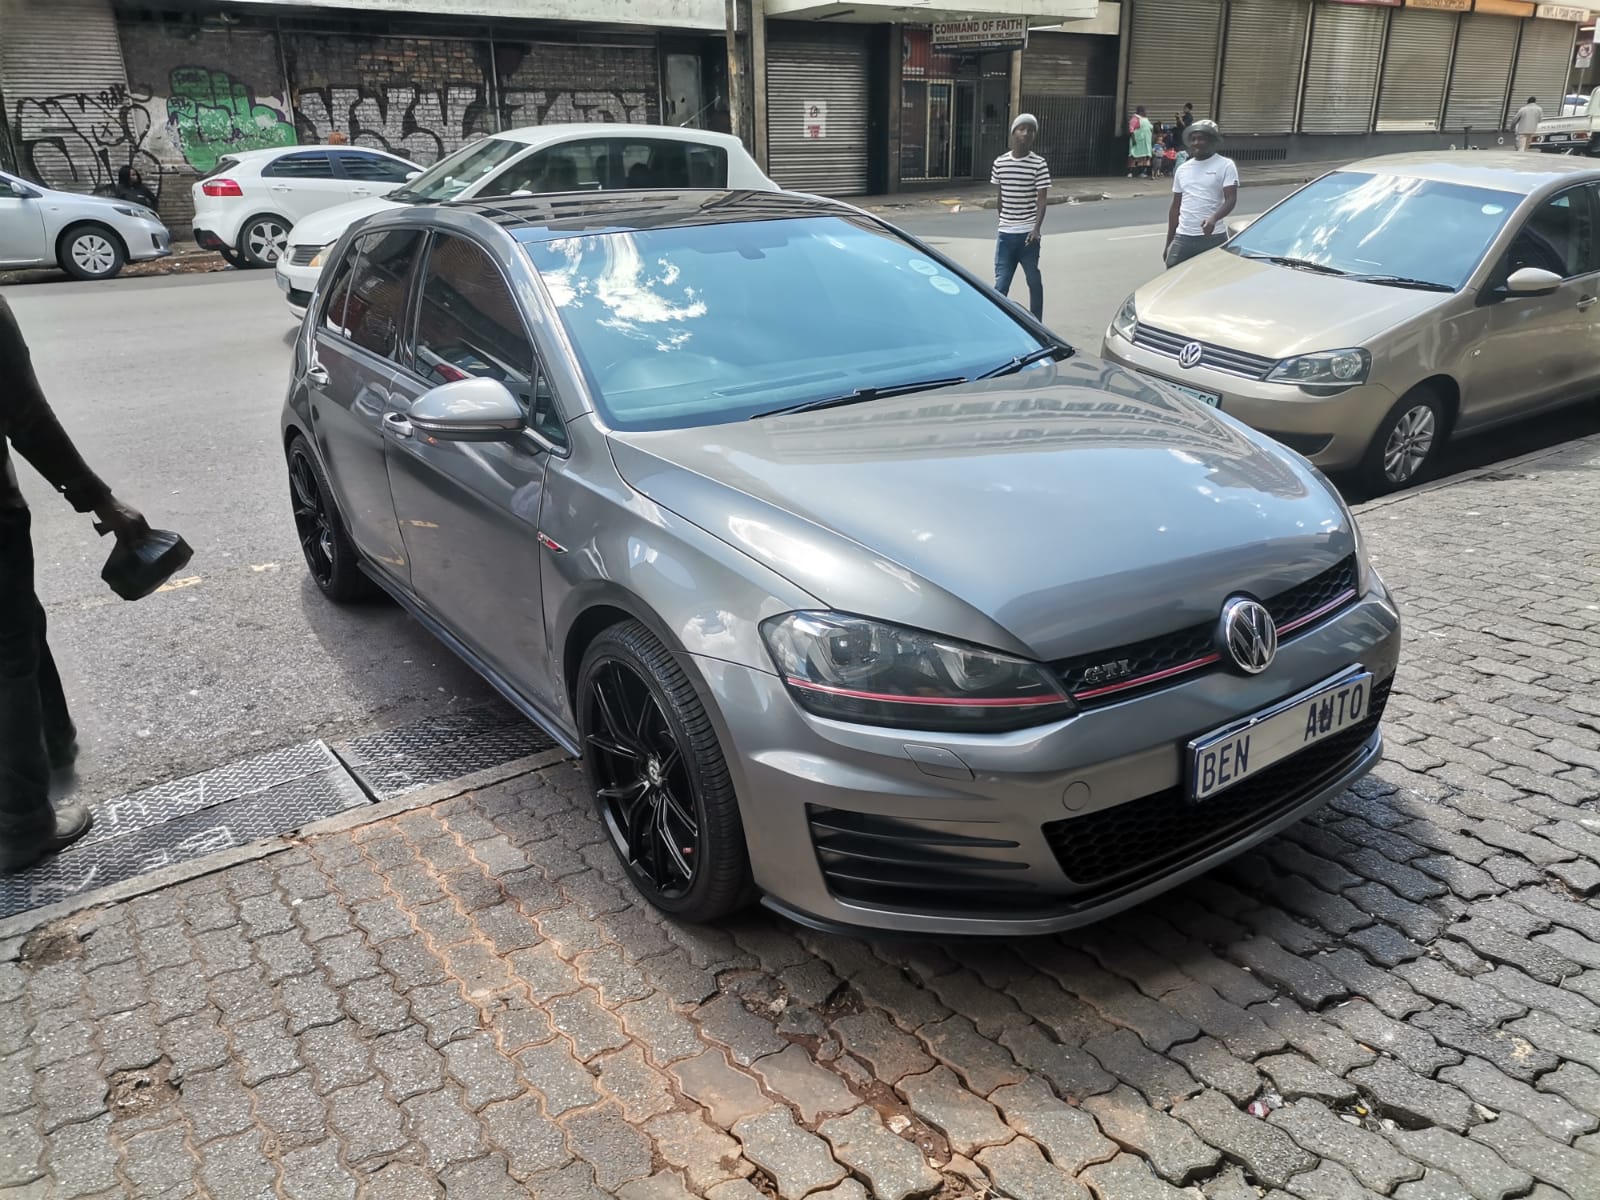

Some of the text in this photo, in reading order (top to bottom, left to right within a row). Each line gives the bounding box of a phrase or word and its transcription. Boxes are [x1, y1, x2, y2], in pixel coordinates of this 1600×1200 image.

[934, 18, 1023, 34] COMMAND OF FAITH
[959, 33, 988, 41] MINISTRIES
[990, 31, 1022, 39] WORLDWIDE
[1084, 658, 1131, 684] GTI
[1201, 683, 1364, 794] BEN AUTO
